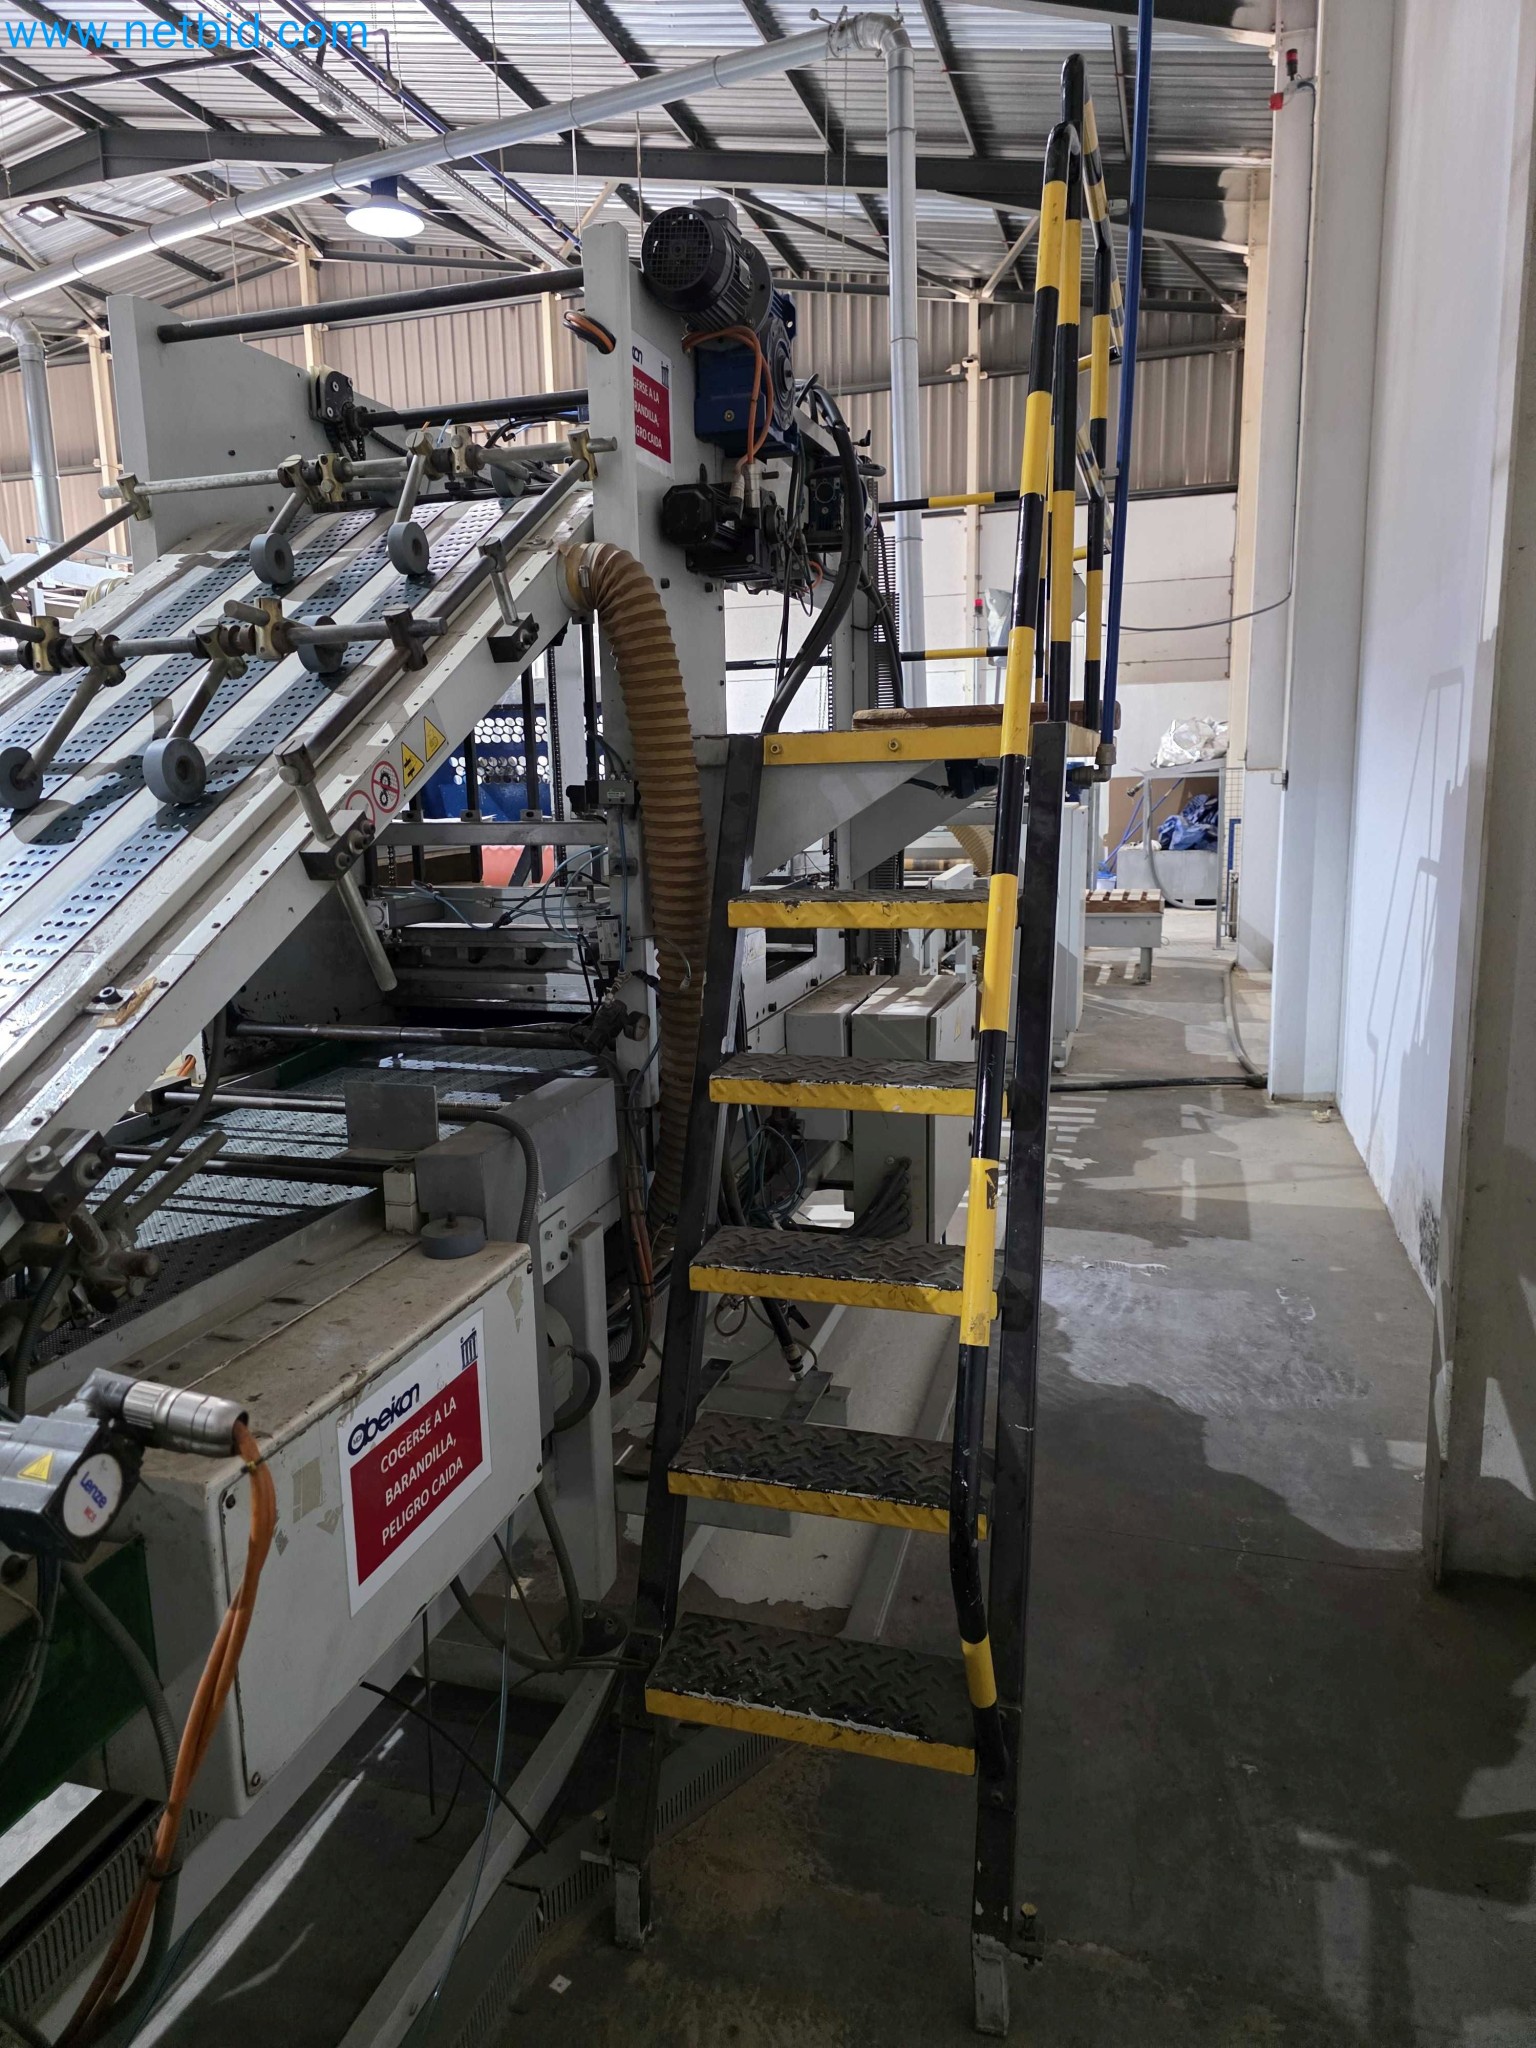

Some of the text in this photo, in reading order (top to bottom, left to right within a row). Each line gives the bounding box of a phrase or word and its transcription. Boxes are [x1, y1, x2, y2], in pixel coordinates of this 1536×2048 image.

[653, 392, 659, 403] LA
[380, 1396, 457, 1474] COGERSE A LA
[385, 1432, 457, 1507] BARANDILLA,
[80, 1471, 107, 1509] Lenze
[382, 1456, 463, 1546] PELIGRO CAIDA
